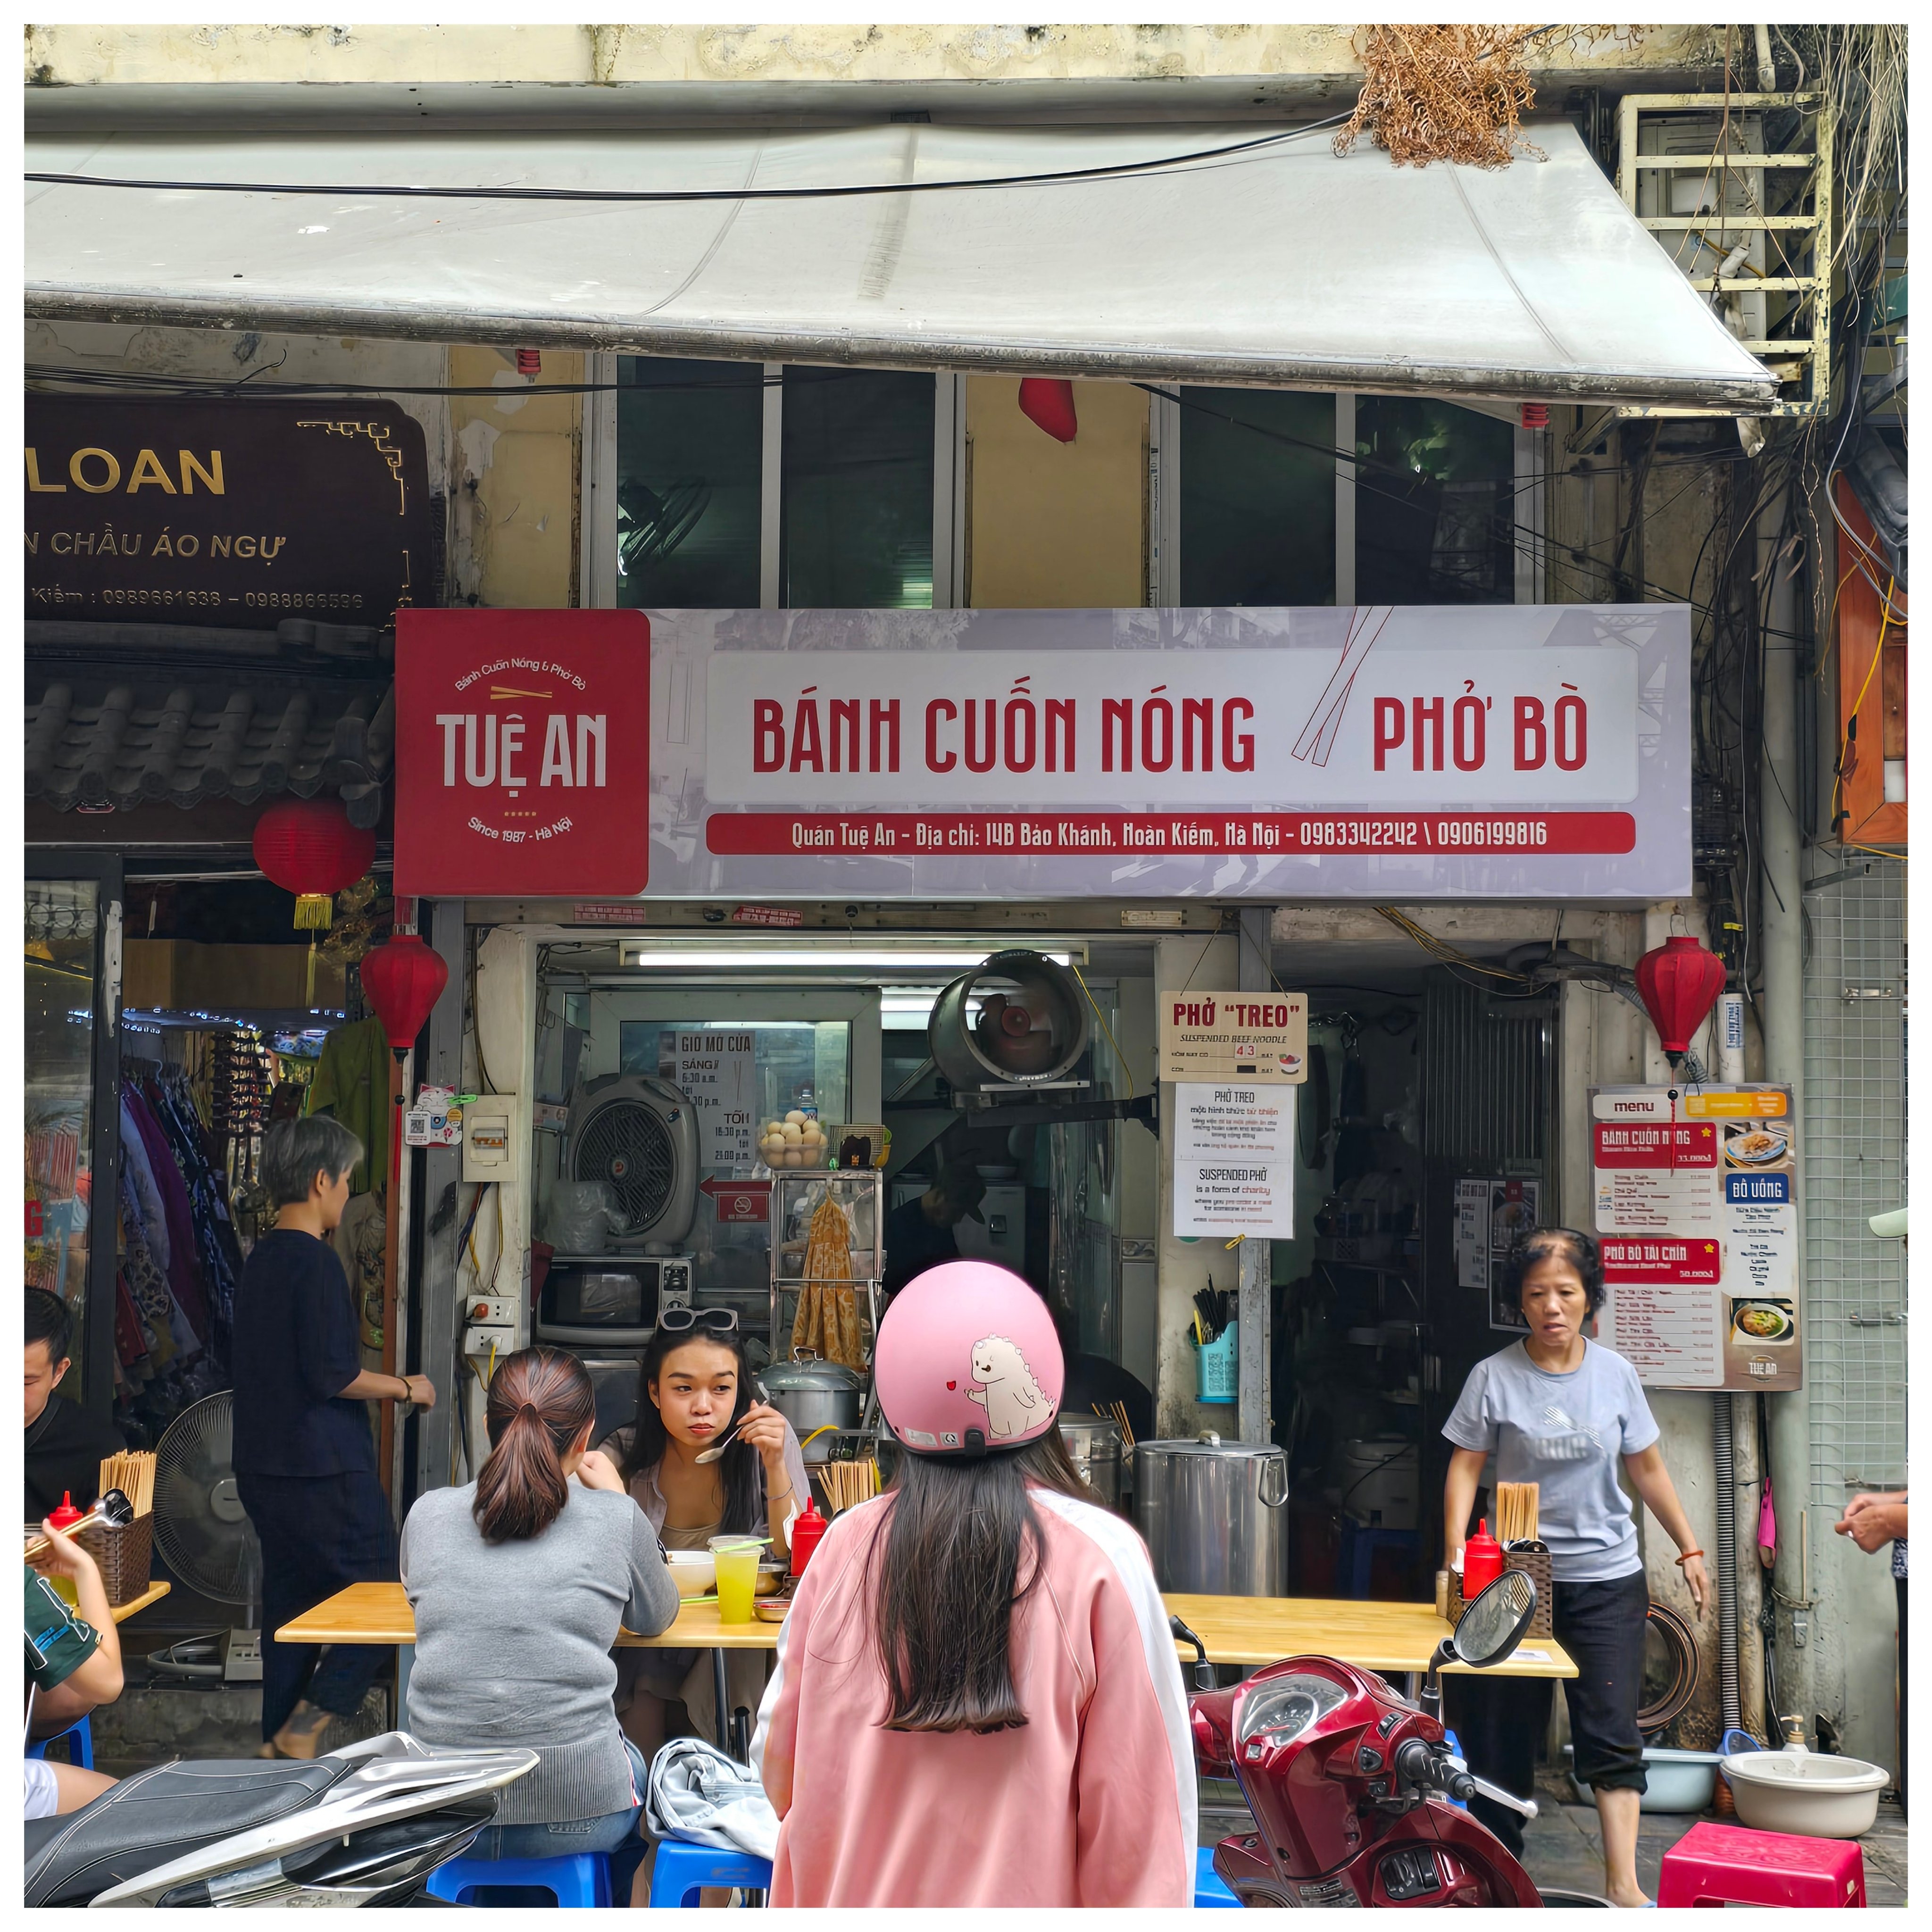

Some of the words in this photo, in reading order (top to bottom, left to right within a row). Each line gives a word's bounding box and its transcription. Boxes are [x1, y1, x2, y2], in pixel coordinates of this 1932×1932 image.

[25, 447, 225, 495] LOAN
[51, 523, 142, 555] CHẦU
[151, 526, 199, 557] ÁO
[210, 535, 287, 566] NGỰ
[103, 590, 220, 606] 0989661638
[455, 671, 481, 691] Bánh
[511, 657, 540, 672] Nóng
[550, 663, 573, 680] Phở
[572, 676, 586, 691] Bò
[753, 685, 900, 773] BÁNH
[925, 675, 1076, 774] CUỐN
[1101, 684, 1255, 773] NÓNG
[1374, 679, 1492, 772] PHỞ
[1514, 683, 1587, 772] BÒ
[436, 714, 527, 797] TUỆ
[540, 715, 606, 786] AN
[468, 817, 499, 839] Since
[502, 830, 526, 842] 1987
[535, 827, 552, 841] Hà
[552, 816, 573, 835] Nội
[791, 823, 834, 849] Quán
[840, 823, 869, 849] Tuệ
[874, 823, 895, 846] An
[916, 823, 942, 849] Địa
[949, 823, 979, 846] chỉ:
[986, 823, 1014, 846] 14B
[1021, 823, 1051, 846] Bảo
[1058, 822, 1116, 847] Khánh,
[1123, 823, 1165, 846] Hoàn
[1172, 822, 1219, 847] Kiếm,
[1225, 823, 1246, 846] Hà
[1253, 822, 1279, 849] Nội
[1300, 822, 1417, 846] 0983342242
[1438, 822, 1547, 845] 0906199816
[1174, 997, 1216, 1026] PHỞ
[728, 1033, 750, 1051] CỬA
[1180, 1034, 1229, 1043] SUSPENDED
[1232, 1035, 1251, 1043] BEEF
[1215, 1088, 1232, 1102] PHỞ
[1234, 1091, 1255, 1103] TREO
[1615, 1102, 1654, 1111] menu
[1632, 1127, 1659, 1144] CUỐN
[1662, 1131, 1690, 1144] NNG
[1199, 1169, 1248, 1180] SUSPENDED
[1250, 1167, 1267, 1181] PHỞ
[1242, 1187, 1270, 1196] charity
[1604, 1244, 1624, 1260] PHỞ
[1662, 1245, 1686, 1260] CHÍN
